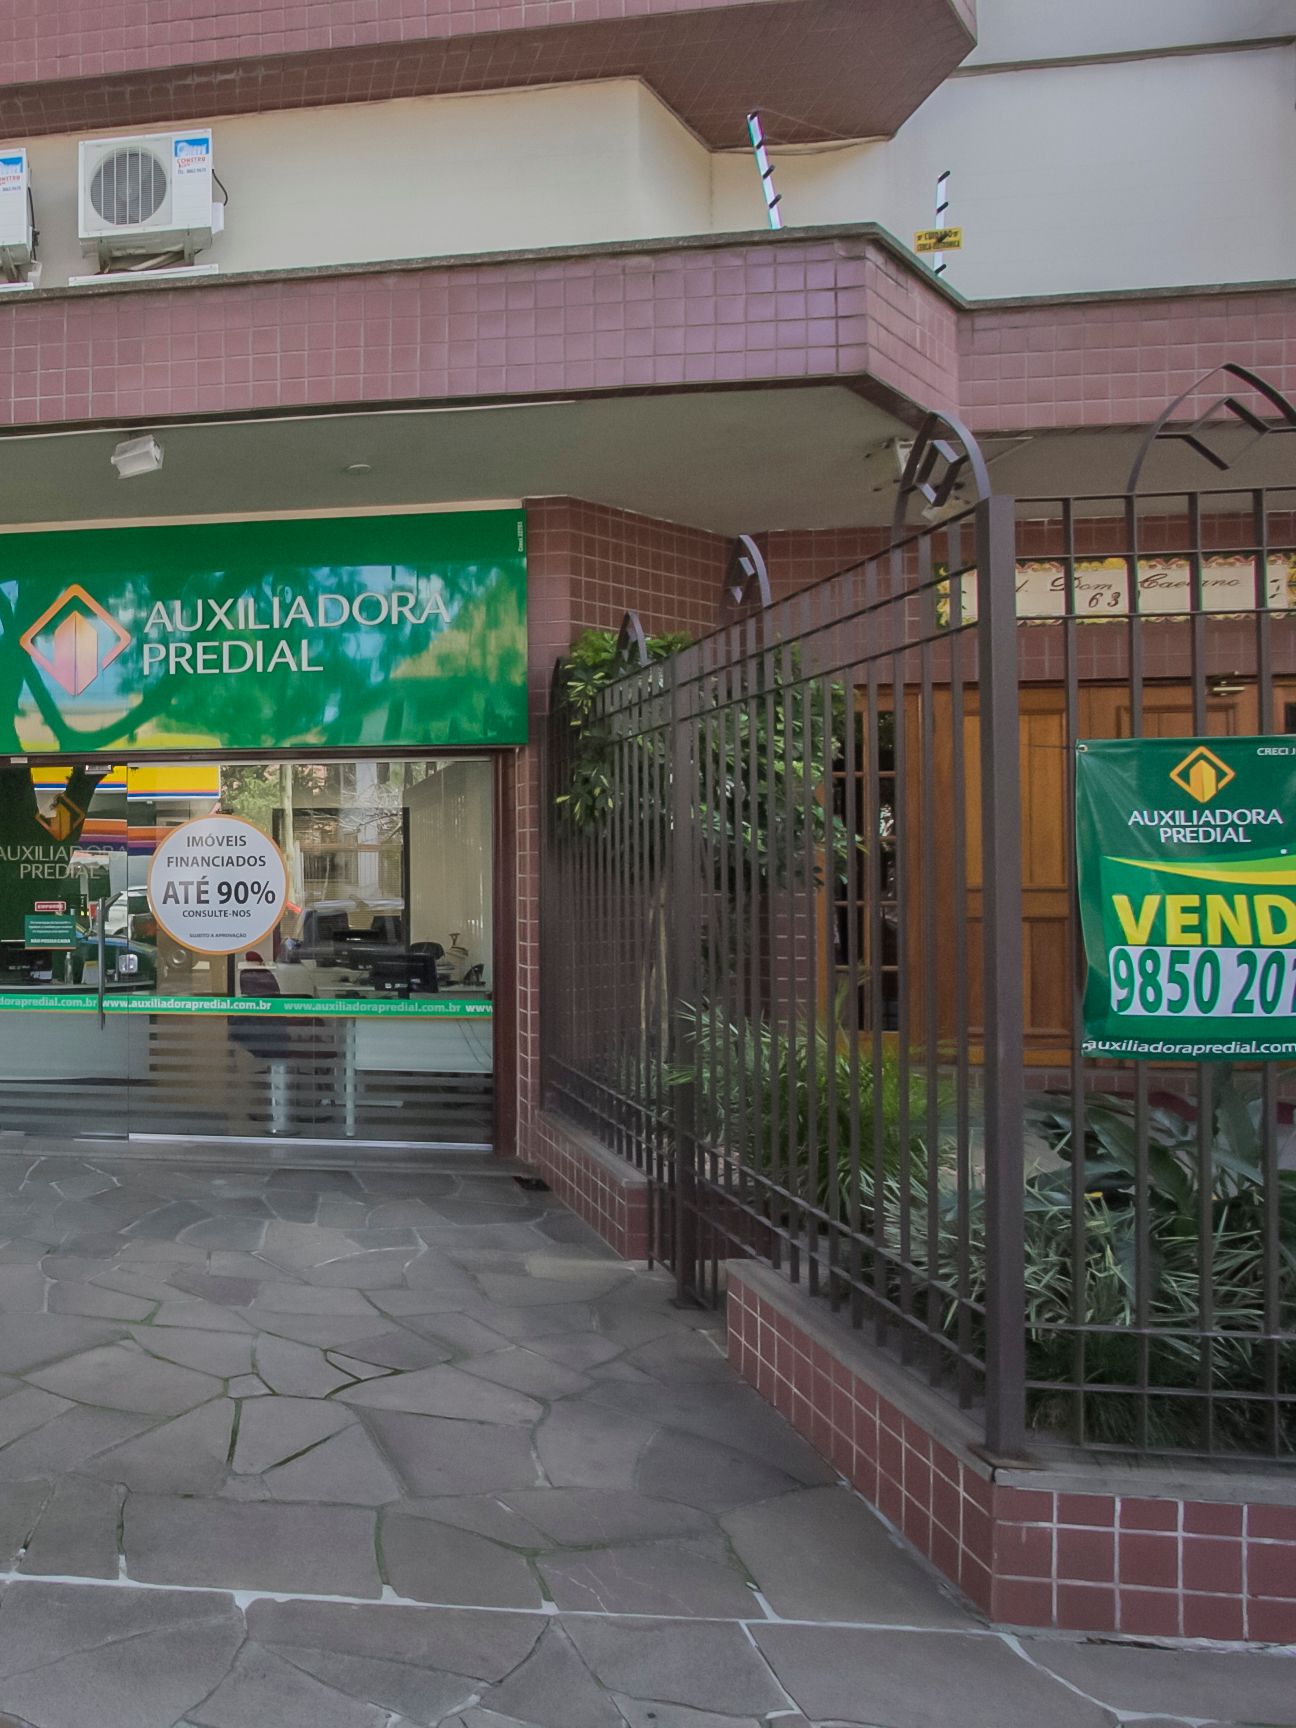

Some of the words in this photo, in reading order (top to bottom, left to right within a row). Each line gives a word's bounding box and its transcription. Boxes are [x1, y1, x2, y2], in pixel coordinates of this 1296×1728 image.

[1138, 573, 1240, 589] Caeno
[143, 591, 453, 632] AUXILIADORA
[143, 639, 324, 676] PREDIAL
[1257, 747, 1289, 756] CRECI
[1128, 808, 1284, 826] AUXILIADORA
[187, 833, 247, 848] IMÓVEIS
[1159, 826, 1252, 844] PREDIAL
[167, 855, 266, 868] FINANCIADOS
[20, 863, 101, 879] PREDIAL
[162, 875, 210, 905] ATÉ
[217, 880, 276, 905] 90%
[182, 909, 252, 918] CONSULTE-NOS
[1112, 947, 1221, 1014] 9850
[103, 997, 272, 1011] www.auxiliadorapredial.com.br
[284, 1001, 461, 1014] www.auxiliadorapredial.com.br
